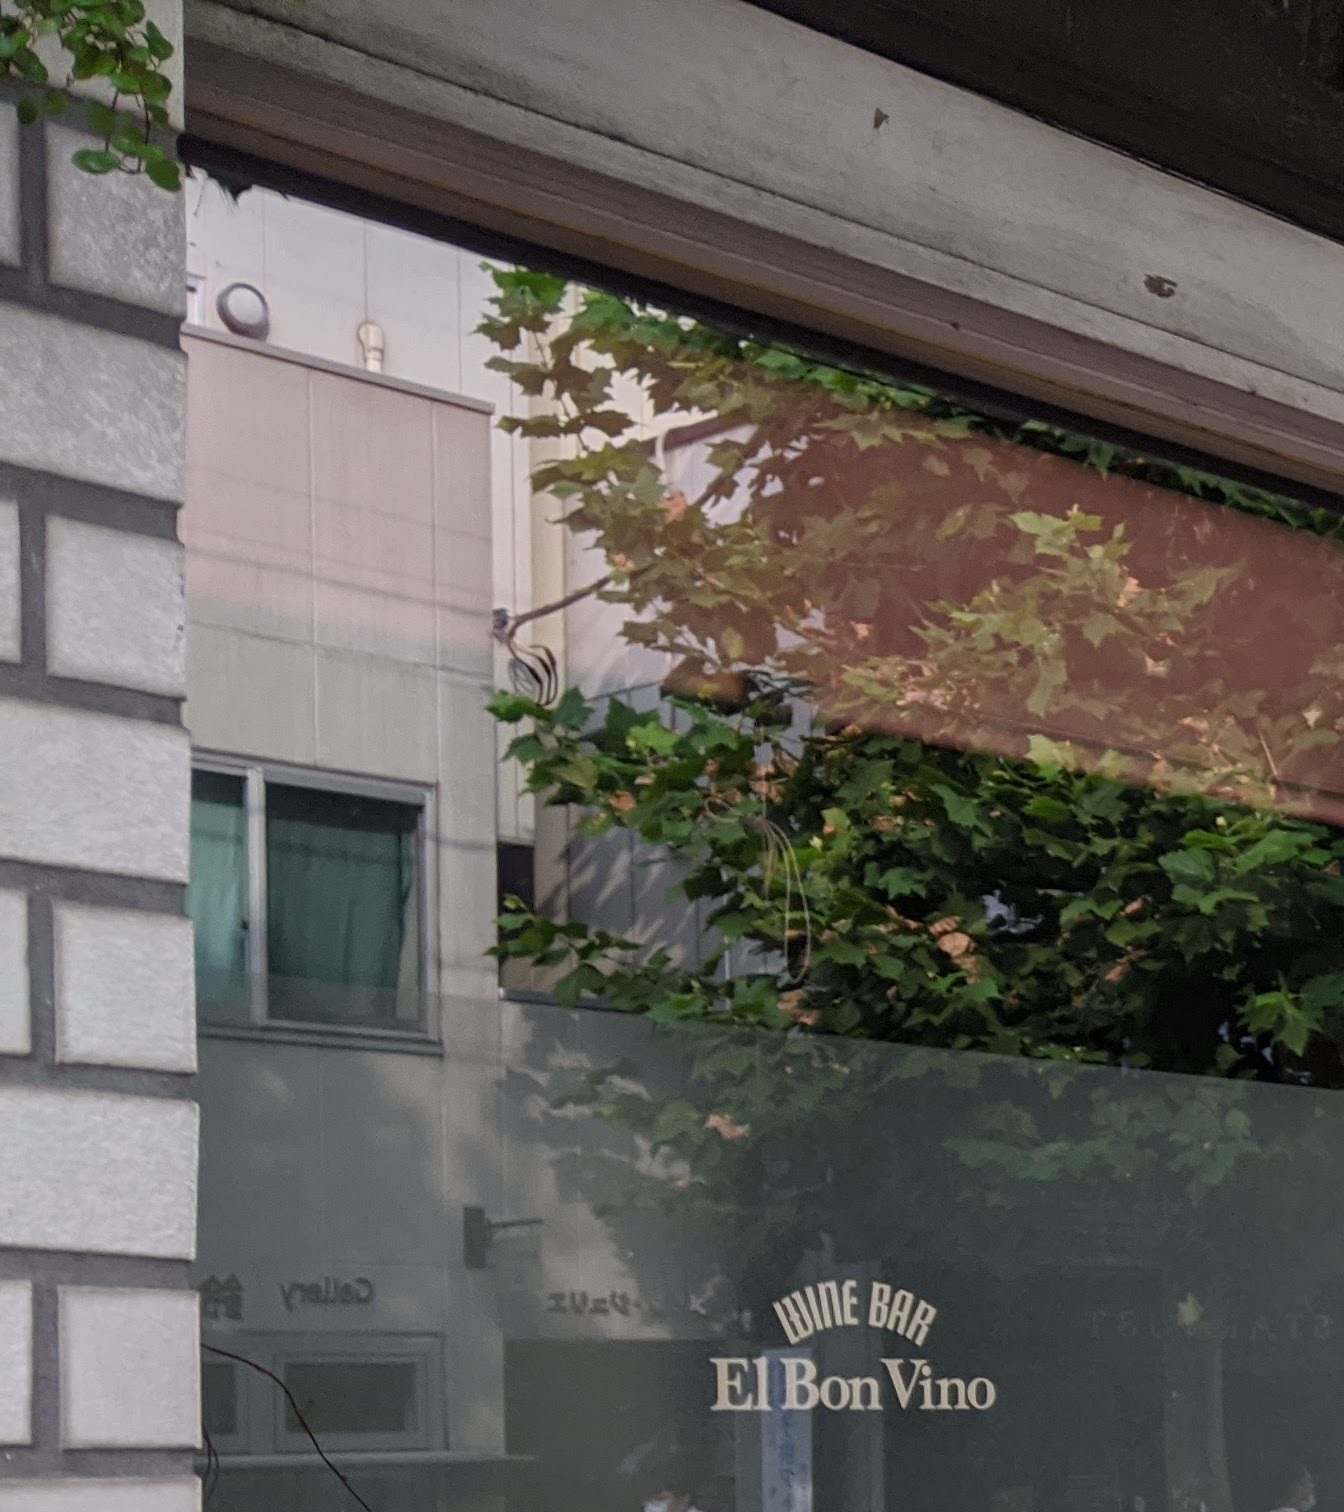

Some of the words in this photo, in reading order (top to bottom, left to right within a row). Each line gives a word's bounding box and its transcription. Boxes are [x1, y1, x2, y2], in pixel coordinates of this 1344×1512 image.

[772, 1279, 859, 1346] WINE
[868, 1281, 937, 1347] BAR
[709, 1356, 773, 1411] El
[780, 1357, 884, 1411] Bon
[880, 1357, 997, 1411] Vino
